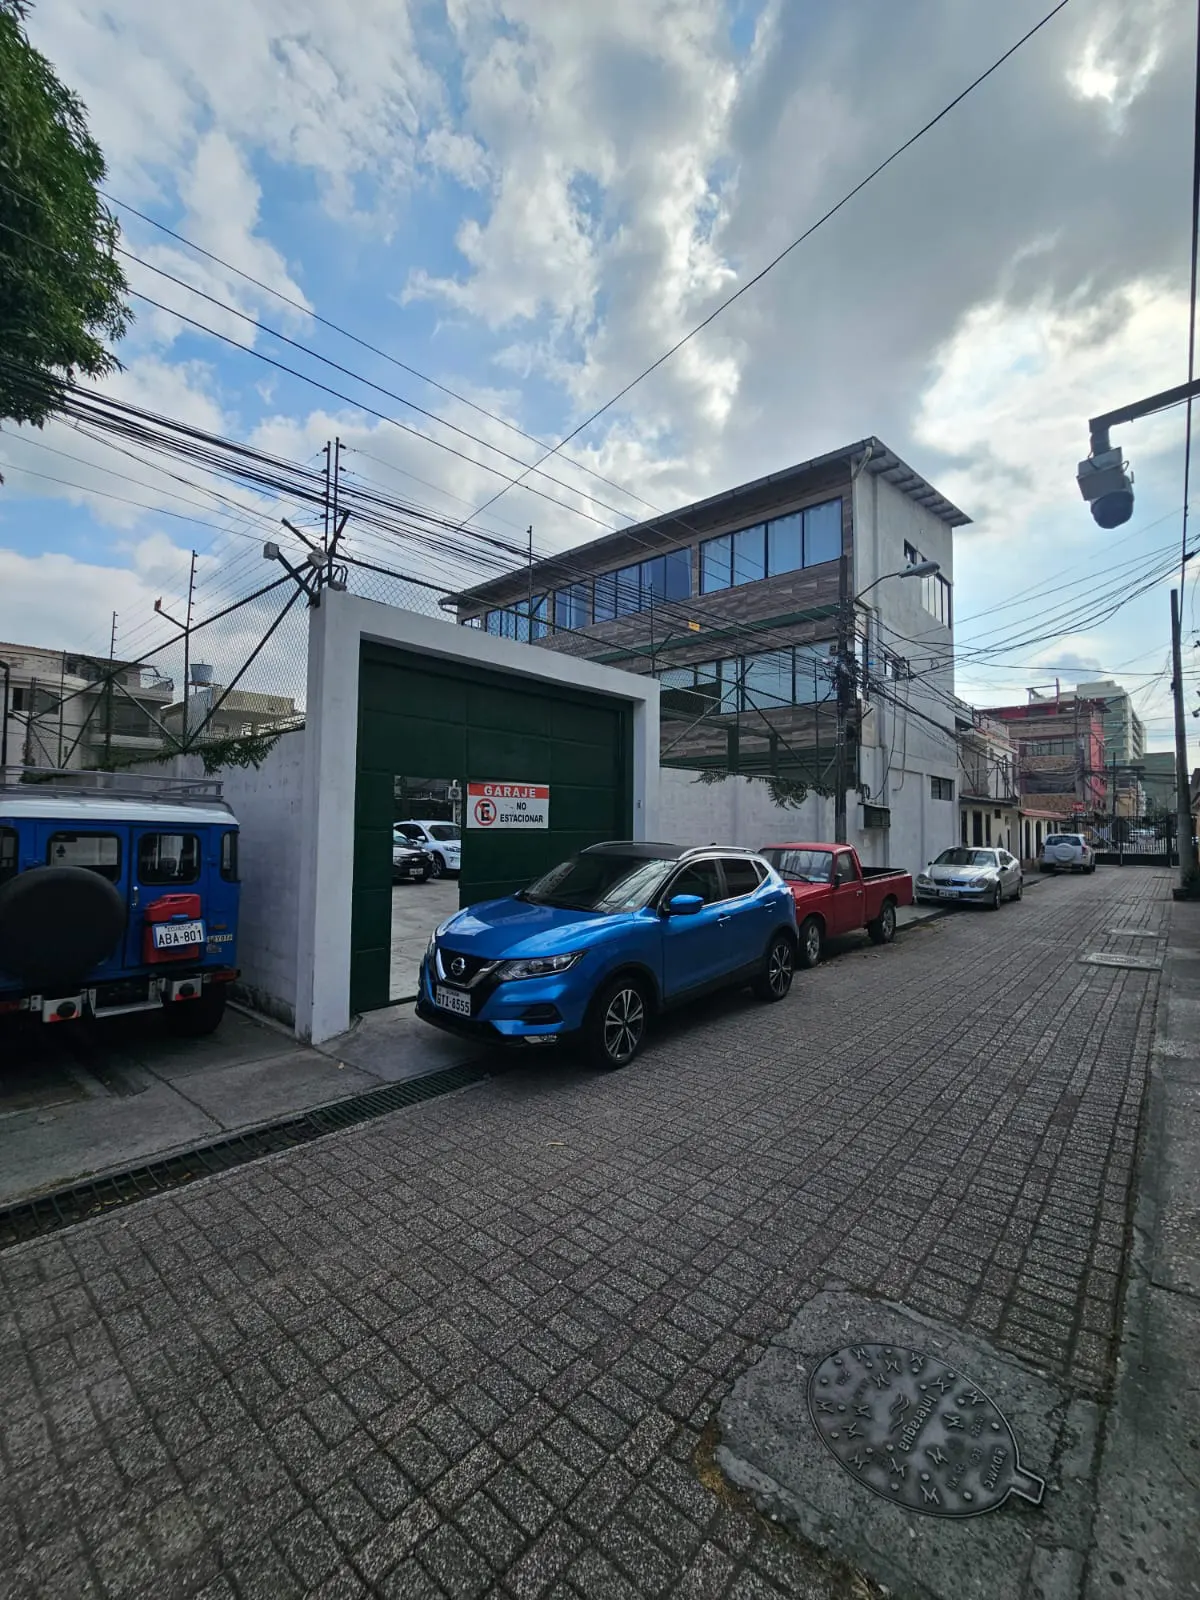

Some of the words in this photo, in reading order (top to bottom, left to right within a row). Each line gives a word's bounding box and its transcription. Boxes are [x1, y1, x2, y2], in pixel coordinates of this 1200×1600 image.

[484, 785, 536, 798] GARAJE
[516, 802, 527, 810] NO
[500, 814, 544, 823] ESTACIONAR
[158, 930, 202, 946] ABA-801
[898, 1394, 937, 1452] Interagua
